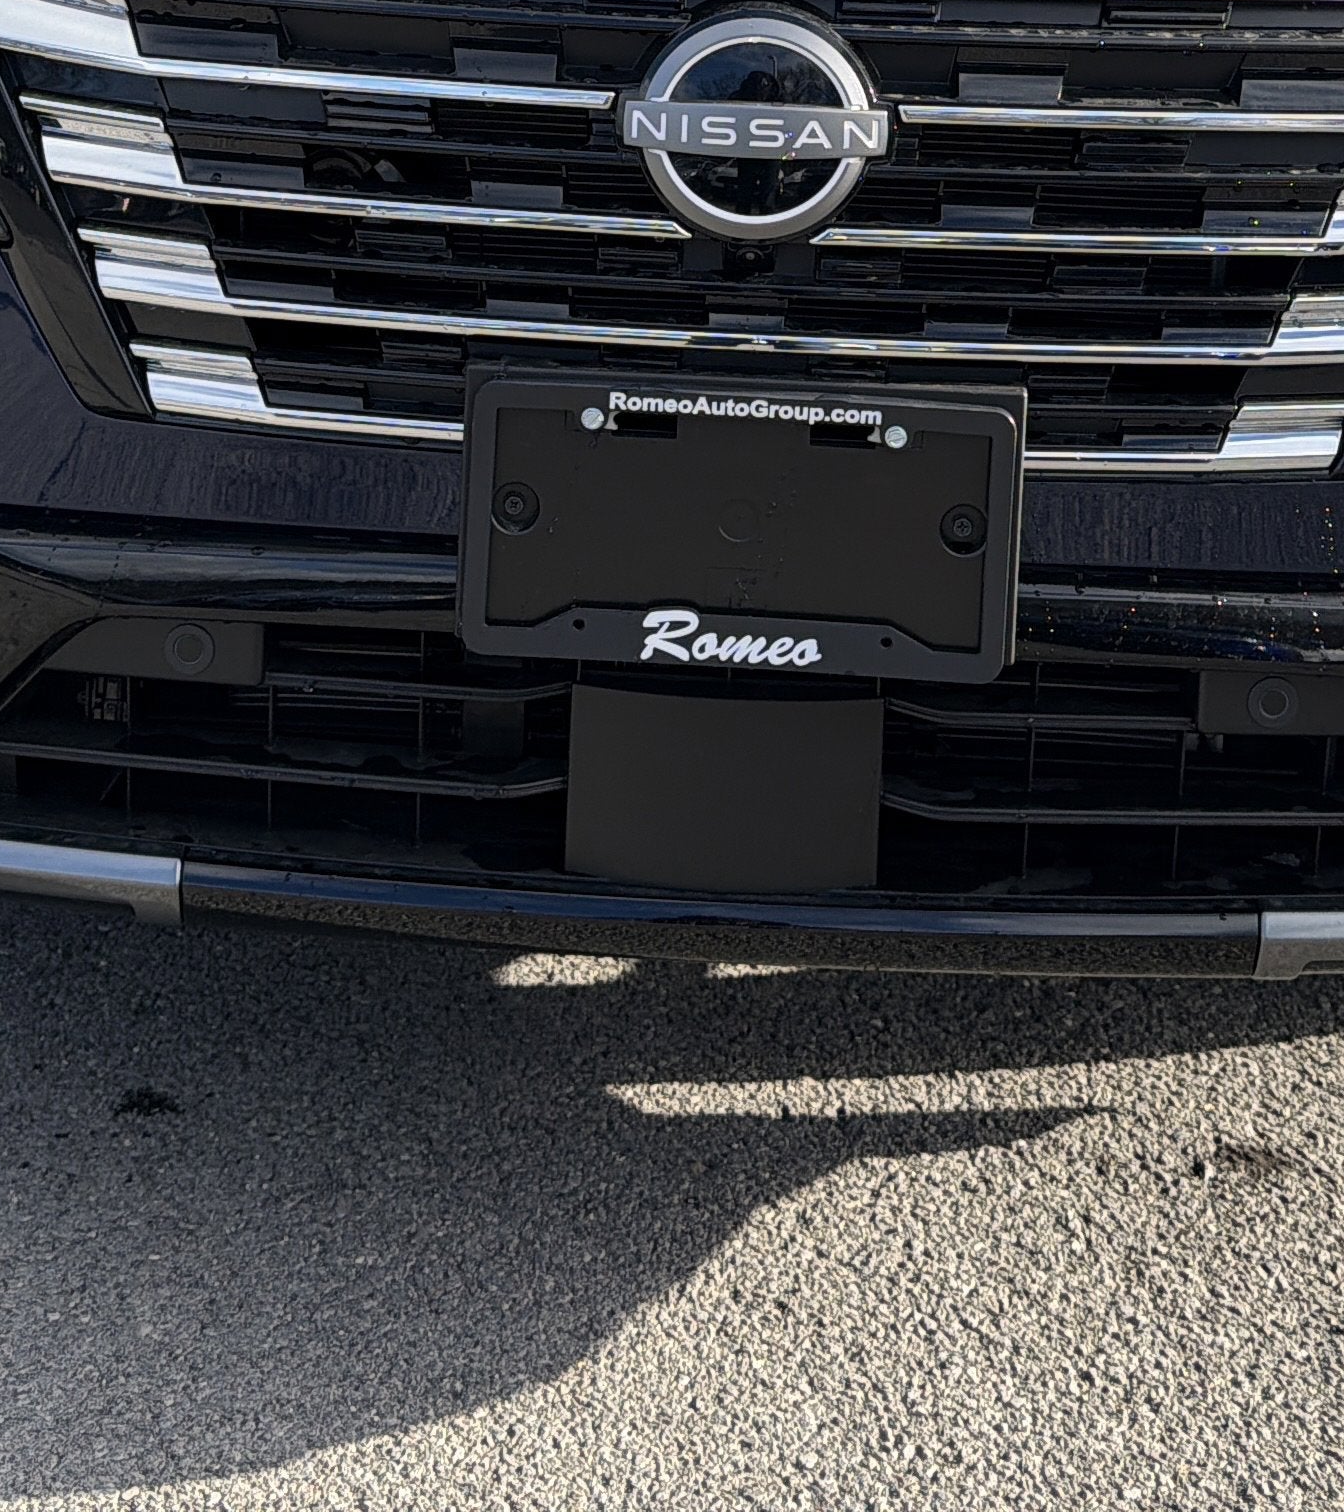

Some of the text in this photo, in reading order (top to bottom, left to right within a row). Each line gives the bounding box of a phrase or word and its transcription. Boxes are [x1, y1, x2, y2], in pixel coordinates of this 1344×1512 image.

[631, 109, 879, 150] NISSAN
[608, 391, 882, 426] RomeoAutoGroup.com
[639, 609, 823, 667] Romeo
